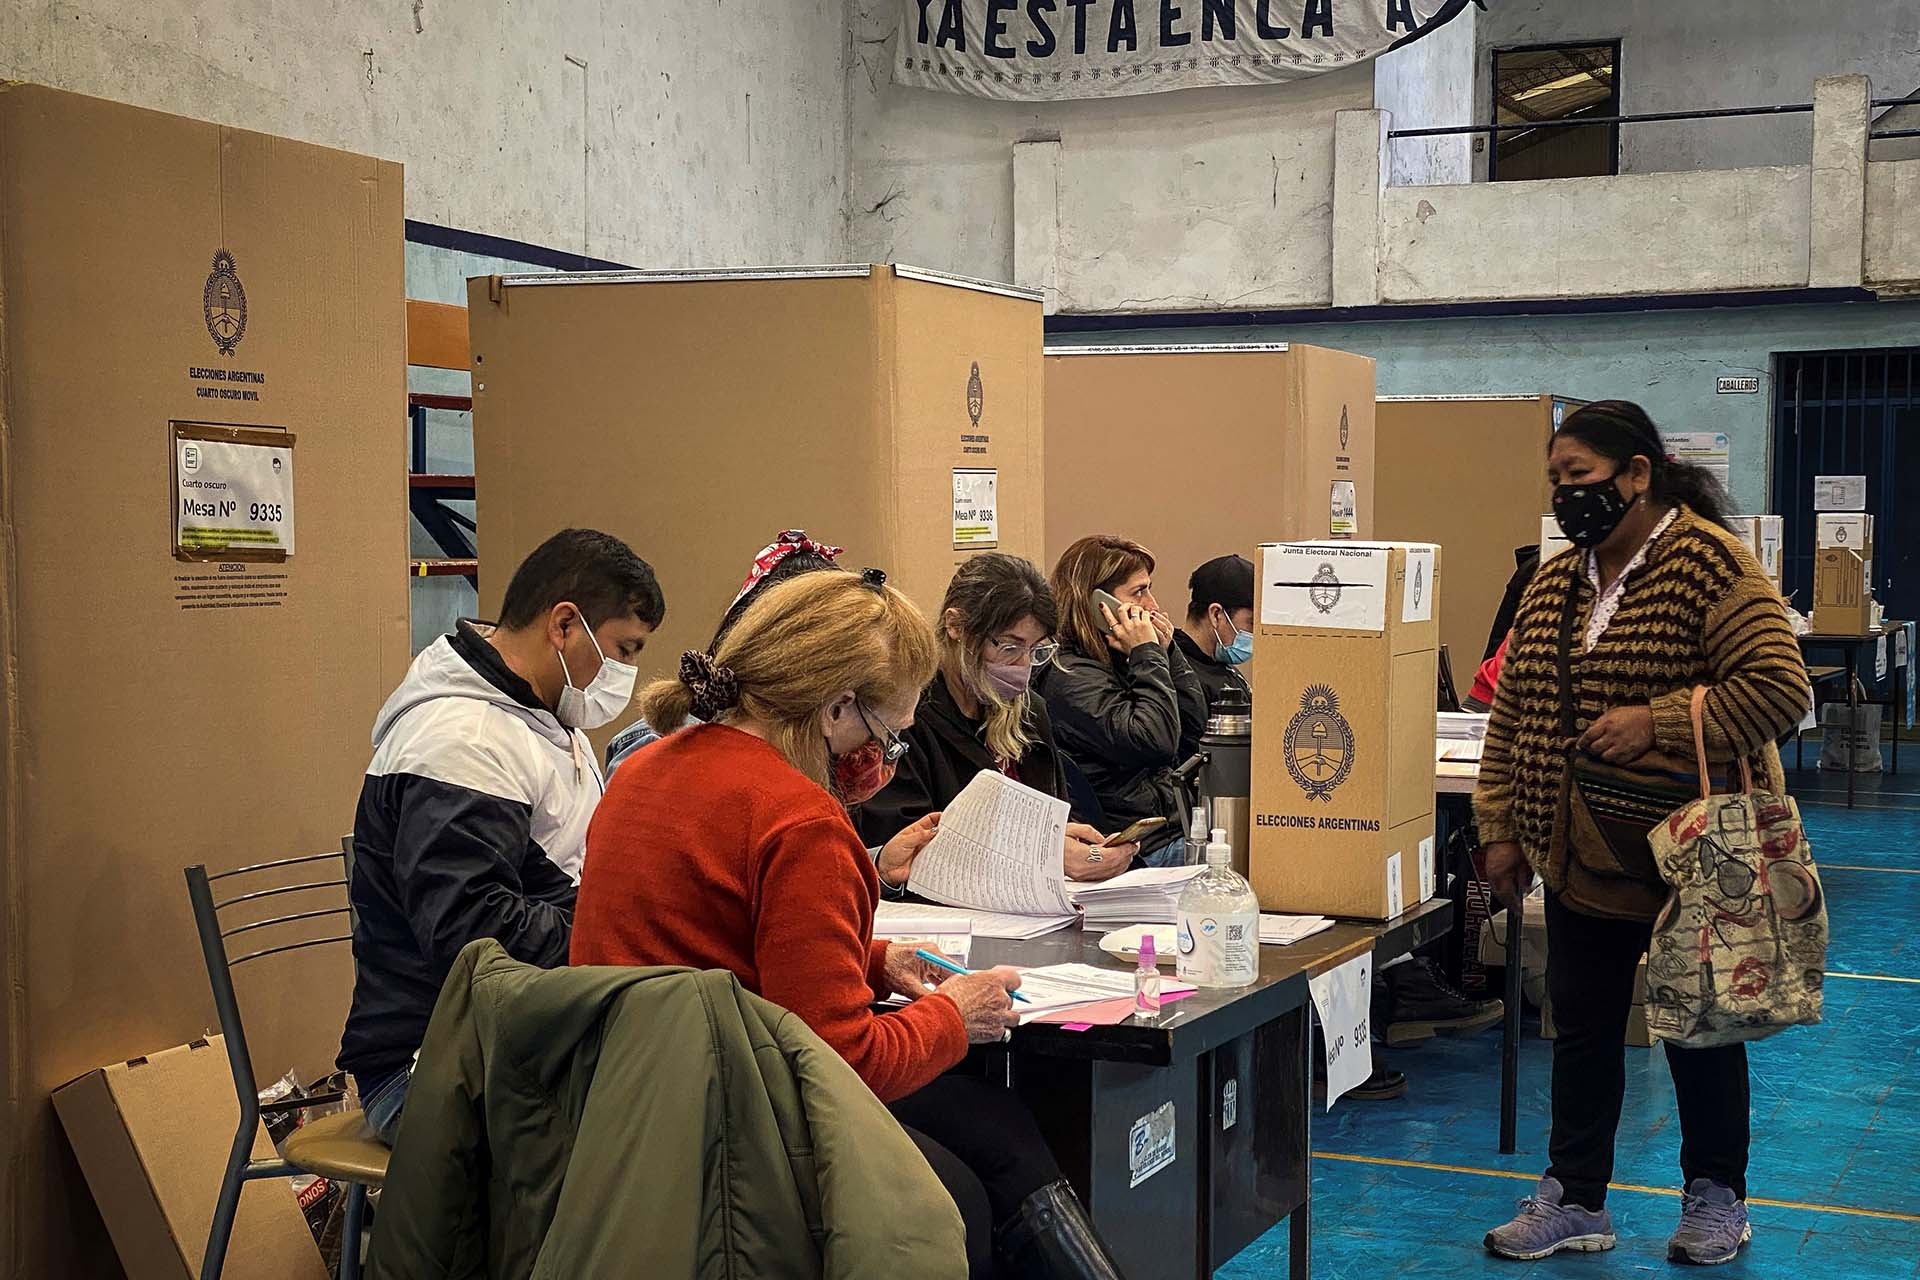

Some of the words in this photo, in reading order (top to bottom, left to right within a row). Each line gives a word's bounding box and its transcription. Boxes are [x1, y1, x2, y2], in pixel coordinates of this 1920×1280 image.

[917, 0, 966, 52] YA
[984, 0, 1137, 58] ESTA
[1159, 0, 1236, 47] EN
[189, 367, 226, 381] ELECCIONES
[228, 370, 265, 384] ARGENTINAS
[1719, 380, 1757, 390] CABALLEROS
[197, 387, 219, 398] CUARTO
[220, 388, 241, 400] OSCURO
[182, 479, 203, 489] Cuarto
[203, 481, 227, 490] oscuro
[183, 498, 216, 517] Mesa
[249, 503, 283, 523] 9335
[1283, 547, 1304, 555] Junta
[1305, 549, 1338, 557] Electoral
[1339, 549, 1373, 558] Nacional
[1256, 814, 1316, 829] ELECCIONES
[1318, 817, 1380, 832] ARGENTINAS
